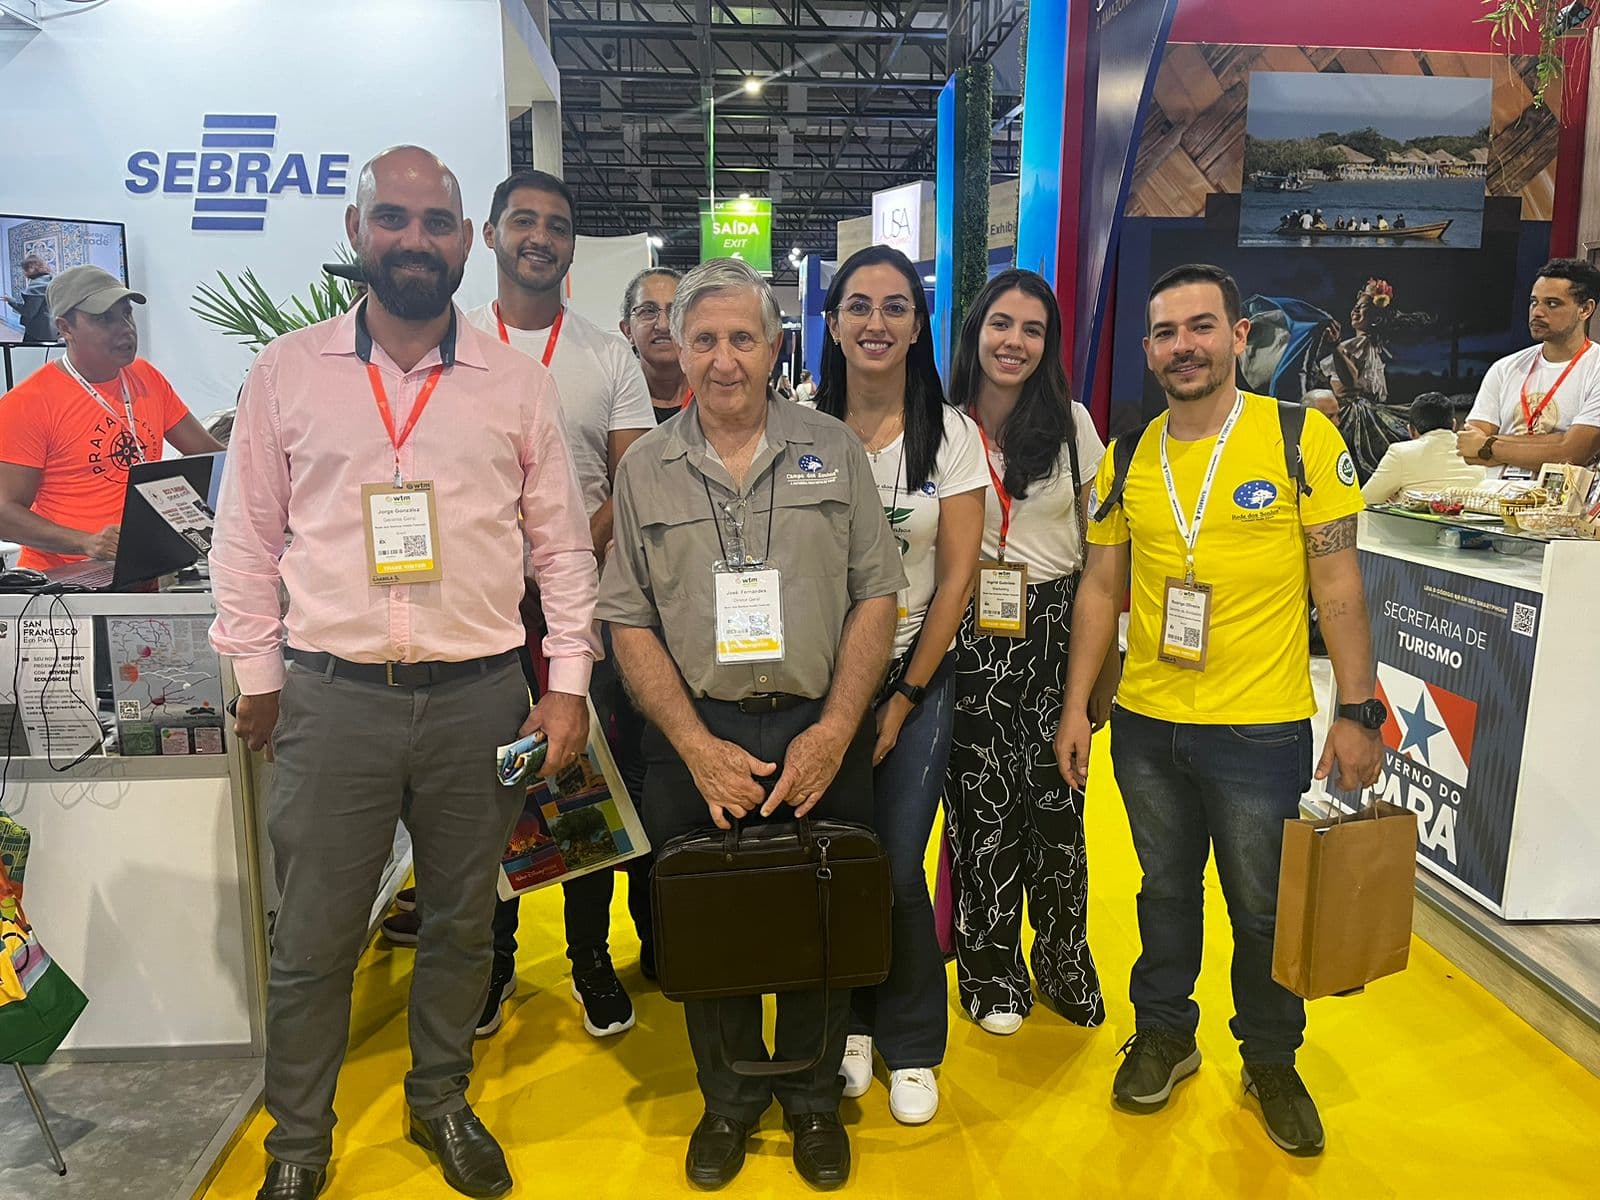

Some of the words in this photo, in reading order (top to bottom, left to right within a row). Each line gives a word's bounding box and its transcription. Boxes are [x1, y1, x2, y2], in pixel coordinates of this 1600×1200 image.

[125, 151, 350, 196] SEBRAE
[713, 219, 760, 235] SAÍDA
[882, 207, 911, 239] USA
[723, 239, 748, 248] EXIT
[89, 416, 117, 475] PRATA
[23, 620, 42, 628] SAN
[23, 628, 78, 636] FRANCESCO
[1383, 600, 1462, 642] SECRETARIA
[1465, 626, 1487, 650] DE
[1398, 630, 1463, 670] TURISMO
[1386, 752, 1432, 788] VERNO
[1439, 783, 1460, 805] DO
